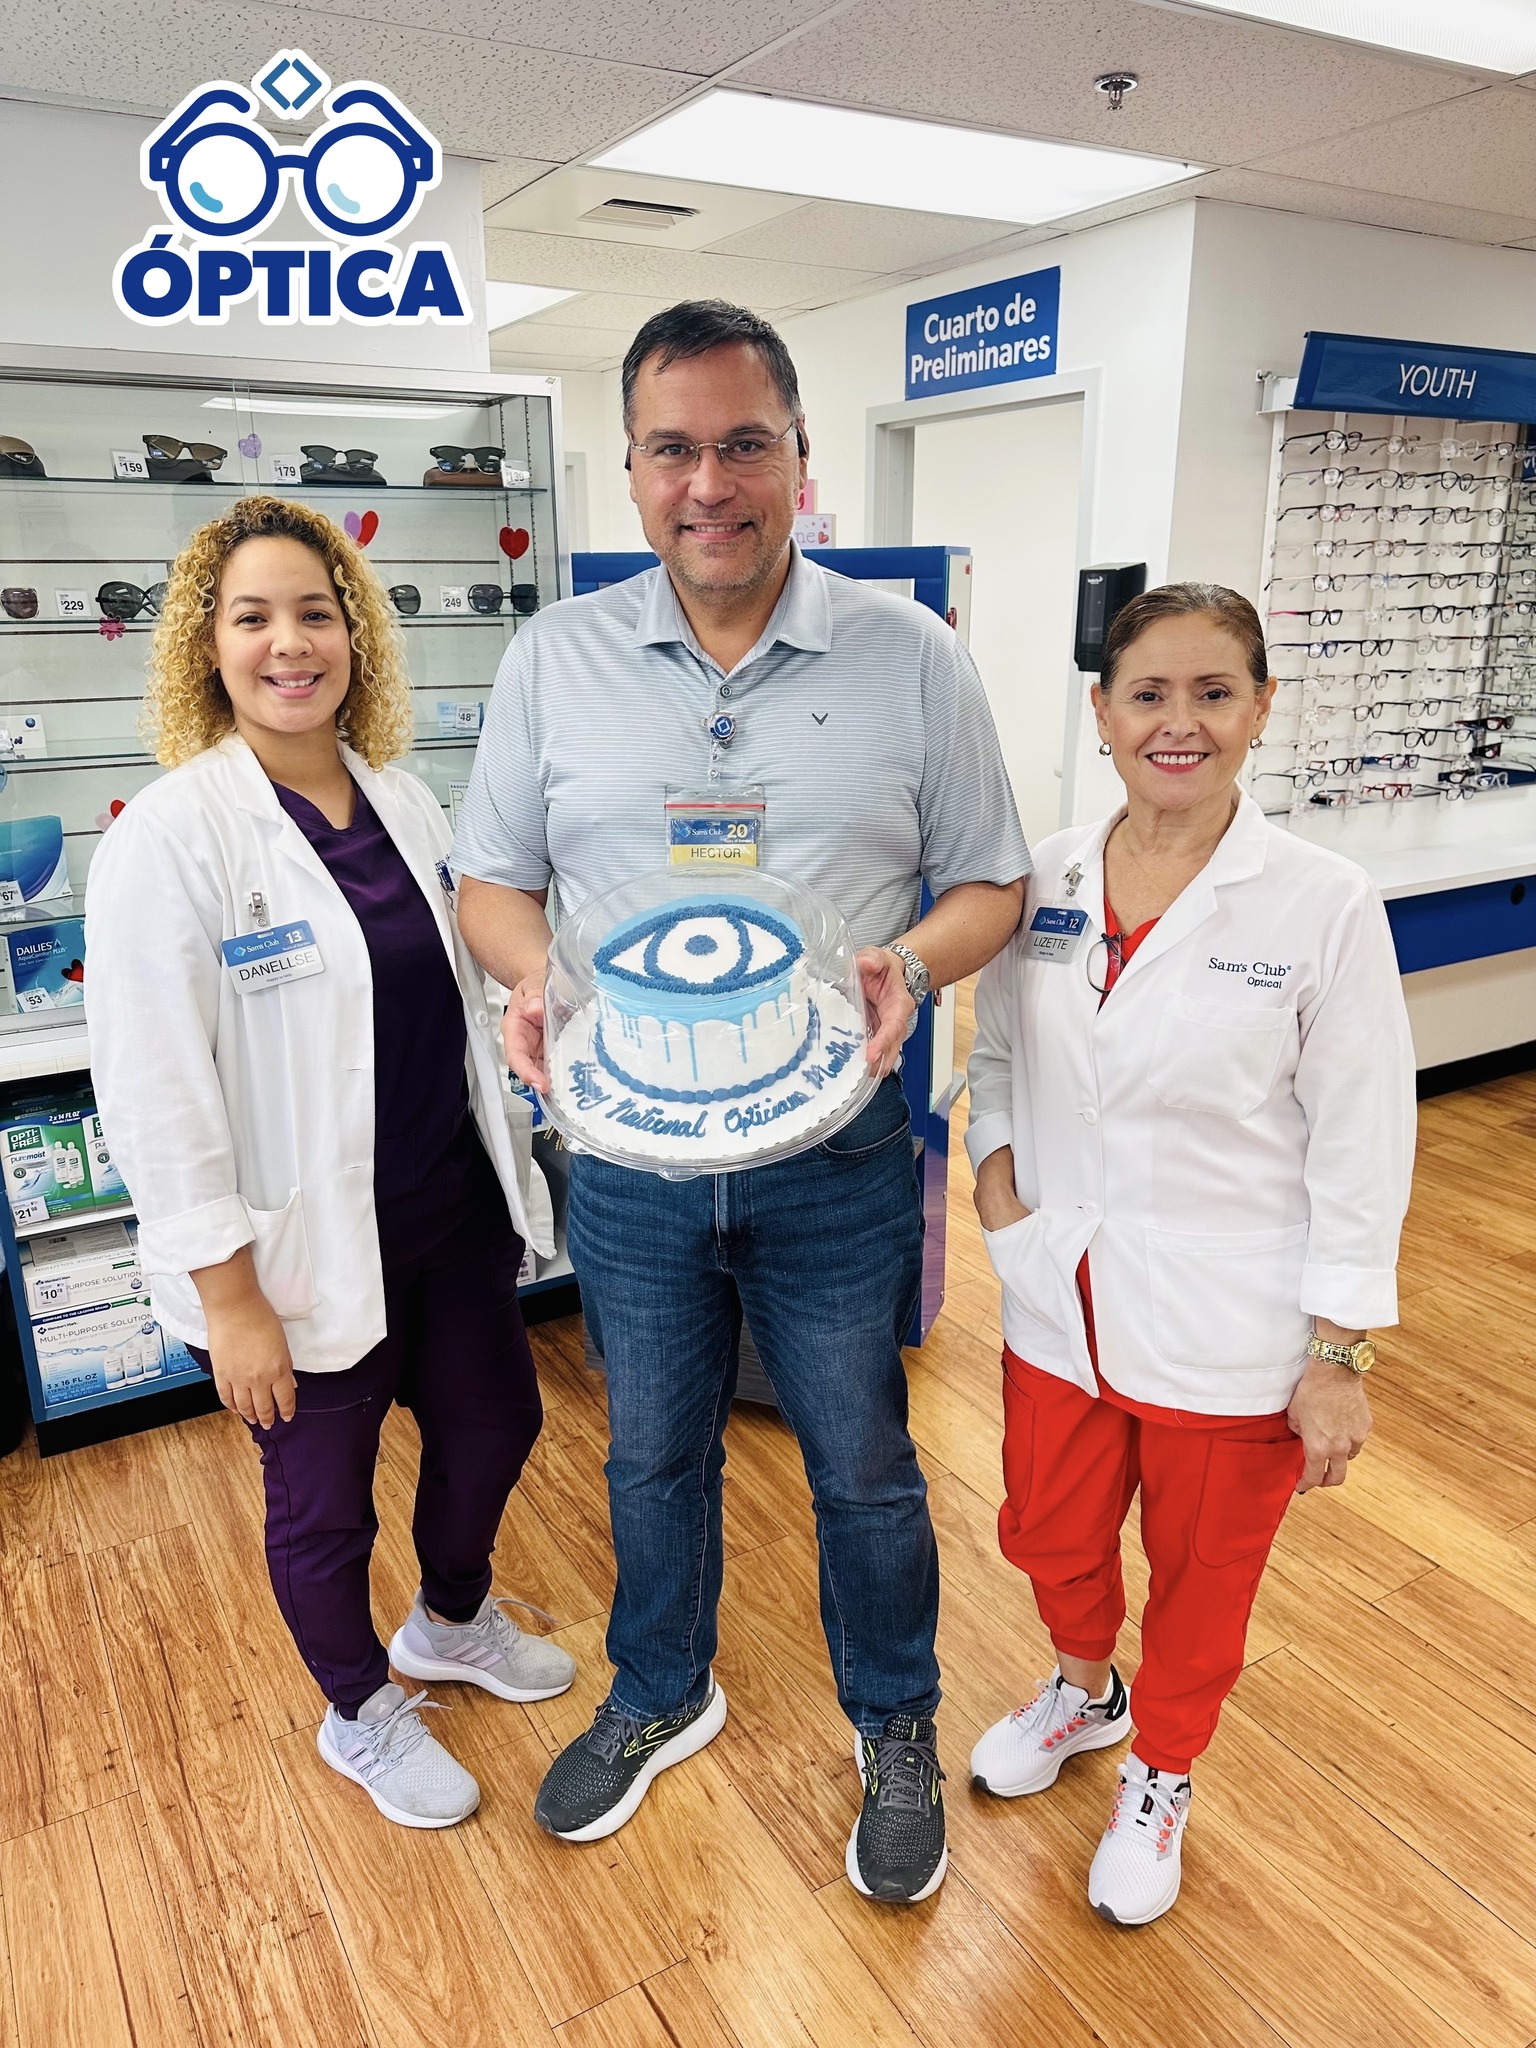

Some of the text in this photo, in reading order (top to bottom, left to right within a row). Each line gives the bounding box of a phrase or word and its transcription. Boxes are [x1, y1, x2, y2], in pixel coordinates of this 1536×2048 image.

[924, 292, 1037, 345] Cuarto de
[910, 334, 1051, 385] Preliminares
[1399, 363, 1477, 399] YOUTH
[120, 462, 142, 473] $159
[274, 466, 296, 477] $179
[60, 600, 84, 611] $229
[442, 598, 462, 608] $249
[728, 824, 748, 839] 20
[691, 848, 741, 858] HECTOR
[1068, 918, 1080, 928] 12
[264, 939, 280, 948] Club
[286, 930, 303, 944] 13
[1034, 936, 1069, 950] LIZETTE
[16, 942, 52, 956] DAILIES
[1208, 957, 1248, 972] Sam's
[1247, 976, 1282, 989] Optical
[605, 1098, 708, 1138] National
[11, 1129, 38, 1143] OPTI-
[12, 1135, 40, 1150] FREE
[11, 1151, 45, 1164] puremoist
[103, 1271, 142, 1283] SOLUTION
[40, 1313, 153, 1344] MULTI-PURPOSE SOLUTION
